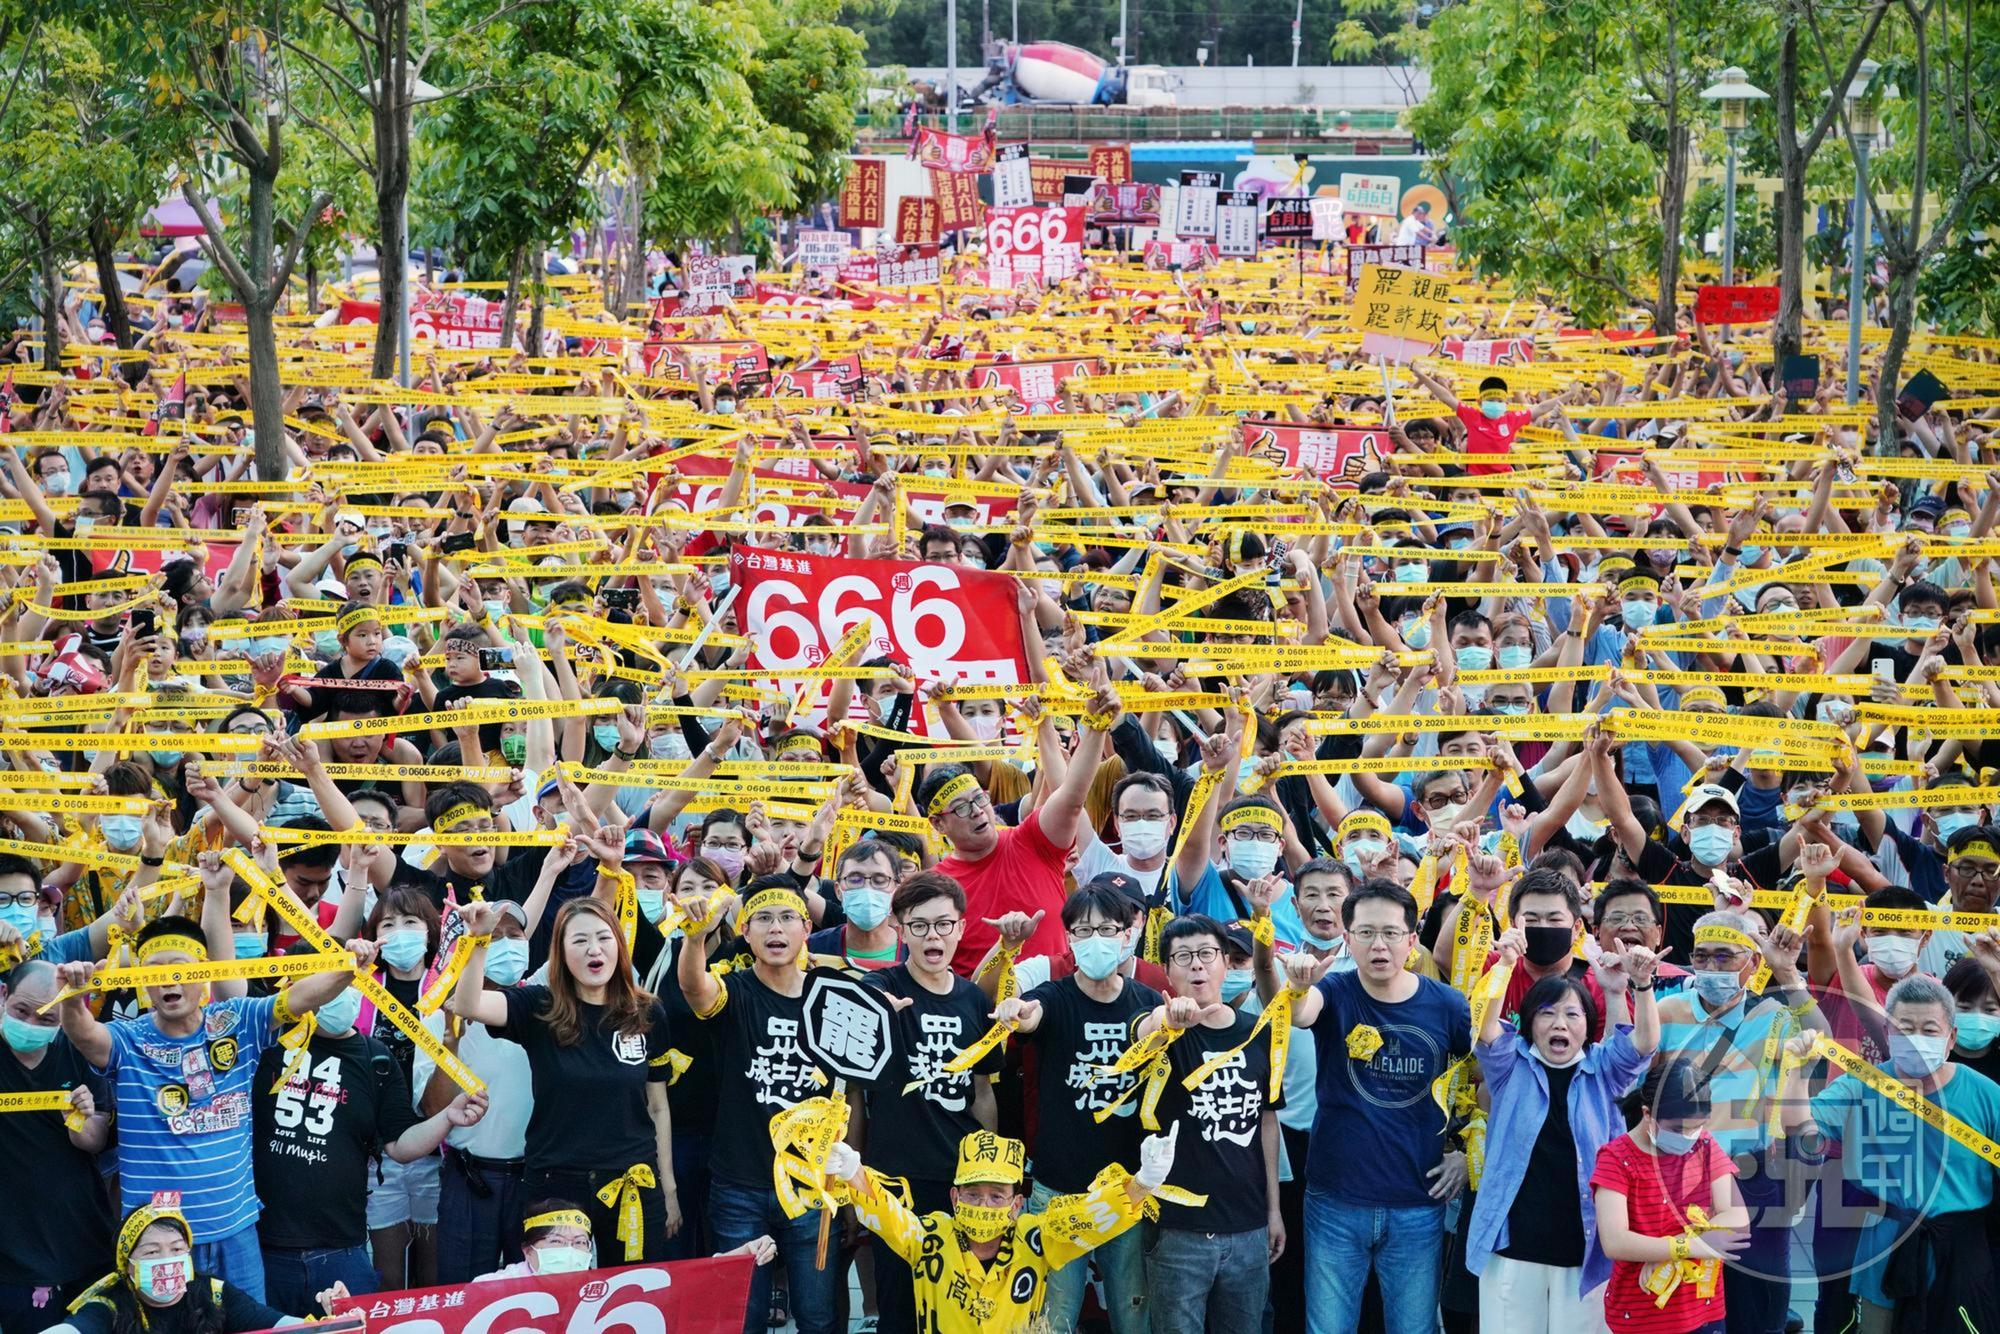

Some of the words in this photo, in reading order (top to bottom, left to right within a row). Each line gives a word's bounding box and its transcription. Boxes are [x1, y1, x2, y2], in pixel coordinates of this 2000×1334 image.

[865, 165, 878, 220] 六月六日
[1348, 191, 1392, 204] 6月6日
[988, 207, 1068, 254] 666
[691, 256, 720, 272] 666
[747, 553, 812, 575] 台灣基進
[1213, 646, 1232, 654] 2020
[219, 662, 237, 672] 2020
[1656, 673, 1676, 681] 0606
[1714, 674, 1733, 682] 2020
[1785, 676, 1806, 684] 0606
[956, 686, 975, 694] 0606
[1015, 684, 1034, 692] 2020
[1015, 684, 1034, 692] 2020
[366, 718, 389, 728] 0606
[436, 712, 459, 723] 2020
[521, 706, 545, 716] 0606
[1361, 720, 1381, 729] 0606
[1425, 718, 1446, 727] 2020
[1503, 716, 1526, 724] 0606
[1639, 710, 1662, 720] 0606
[1706, 715, 1729, 725] 2020
[1789, 721, 1813, 731] 0606
[9, 738, 30, 746] 0606
[258, 763, 281, 773] 0606
[326, 766, 347, 774] 2020
[408, 767, 431, 776] 0606
[1362, 761, 1384, 769] 2020
[2, 774, 25, 782] 0606
[585, 772, 609, 782] 0606
[658, 778, 681, 788] 2020
[746, 784, 772, 793] 0606
[64, 799, 88, 808] 0606
[1850, 797, 1874, 807] 0606
[1922, 794, 1945, 804] 2020
[1232, 809, 1252, 821] 2020
[888, 818, 910, 829] 2020
[22, 844, 44, 852] 2020
[1460, 910, 1470, 933] 0606
[1878, 912, 1903, 922] 0606
[1955, 916, 1980, 926] 2020
[106, 976, 132, 985] 0606
[186, 970, 211, 980] 2020
[282, 962, 309, 972] 0606
[397, 1011, 420, 1033] 0606
[819, 989, 880, 1069] 罷
[1365, 1056, 1424, 1073] ADELAIDE
[273, 1092, 335, 1136] 53
[275, 1129, 296, 1139] LOVE
[307, 1135, 327, 1145] LIFE
[819, 1128, 832, 1152] 0606
[369, 1291, 466, 1320] 台灣基進
